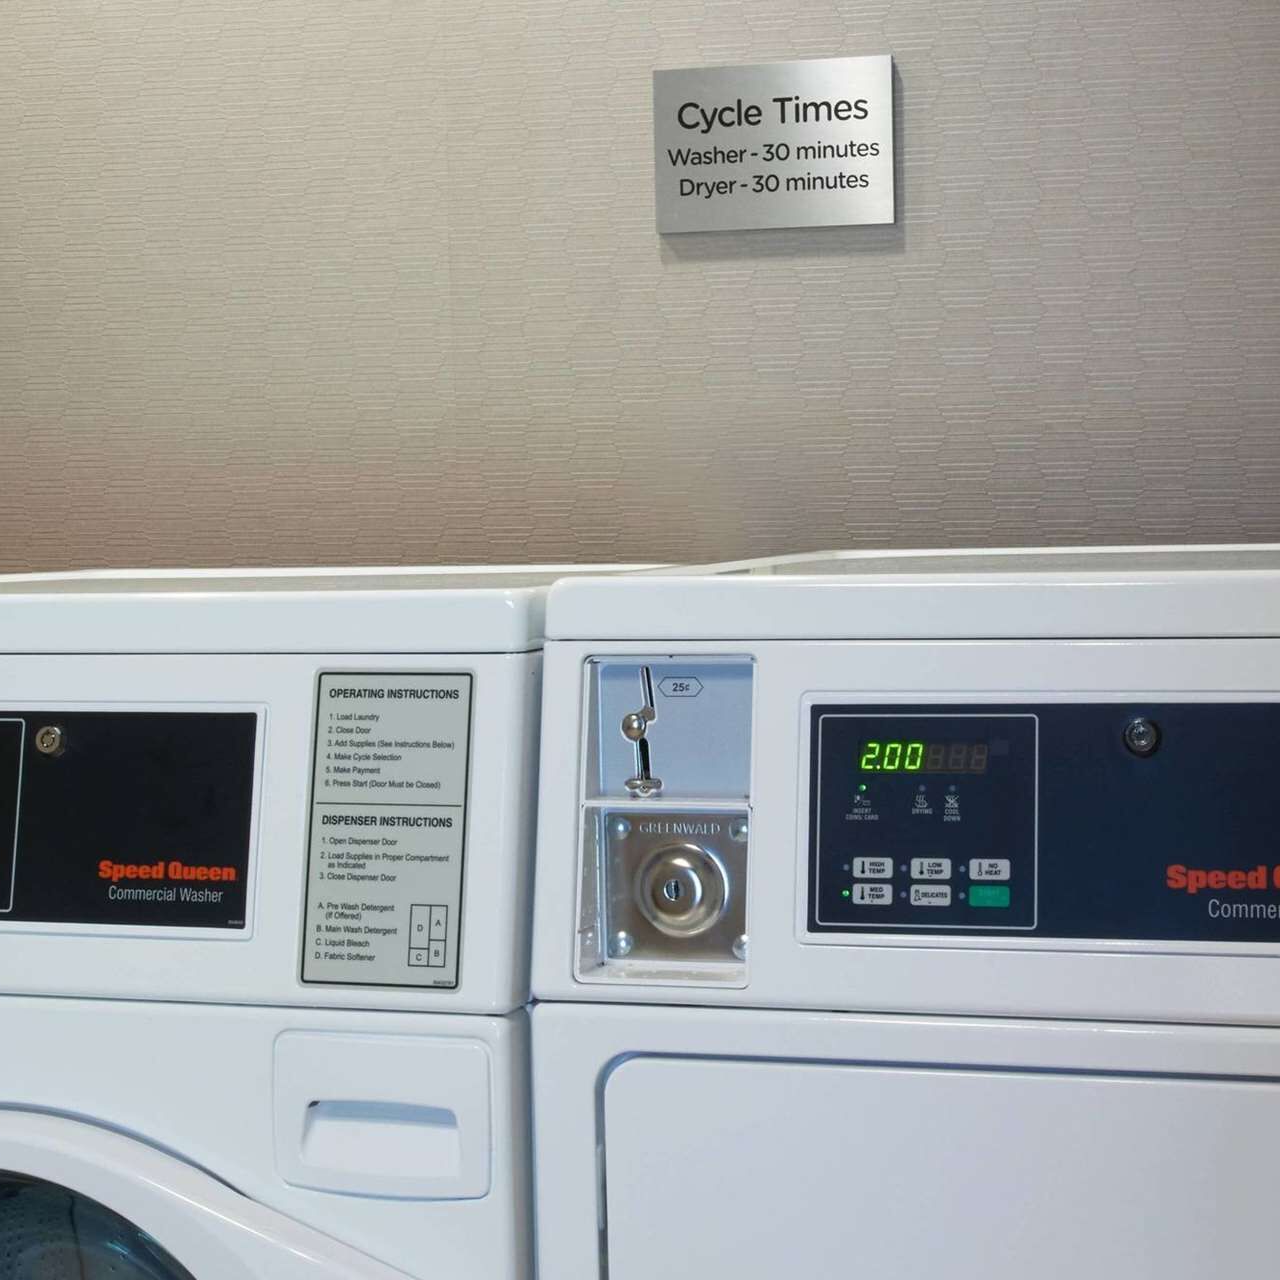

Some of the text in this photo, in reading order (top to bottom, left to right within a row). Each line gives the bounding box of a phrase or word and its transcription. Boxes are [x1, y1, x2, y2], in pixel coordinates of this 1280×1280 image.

[677, 96, 869, 134] Cycle Times
[667, 146, 747, 166] Washer
[762, 143, 790, 162] 30
[796, 140, 880, 160] minutes
[679, 177, 737, 199] Dryer
[752, 174, 780, 192] 30
[786, 172, 870, 192] minutes
[329, 688, 460, 700] OPERATING INSTRUCTIONS
[354, 713, 380, 722] Laundry
[336, 726, 353, 734] Close
[349, 740, 376, 749] Supplies
[334, 753, 351, 761] Make
[353, 754, 371, 762] Cycle
[861, 743, 923, 770] 2.00
[333, 766, 380, 776] Make Payment
[352, 780, 368, 788] Start
[322, 815, 453, 827] DISPENSER INSTRUCTIONS
[329, 837, 398, 847] Open Dispenser Door
[328, 852, 344, 860] Load
[346, 853, 373, 861] Supplies
[382, 853, 403, 862] Proper
[405, 854, 449, 863] Compartment
[98, 860, 236, 882] Speed Queen
[347, 873, 379, 882] Dispenser
[1167, 865, 1267, 893] Speed
[109, 885, 224, 902] Commercial Washer
[341, 903, 359, 911] Wash
[361, 904, 395, 913] Detergent
[343, 926, 362, 934] Wash
[364, 927, 397, 936] Detergent
[325, 939, 345, 947] Liquid
[346, 939, 369, 947] Bleach
[324, 952, 344, 960] Fabric
[347, 953, 375, 961] Softener
